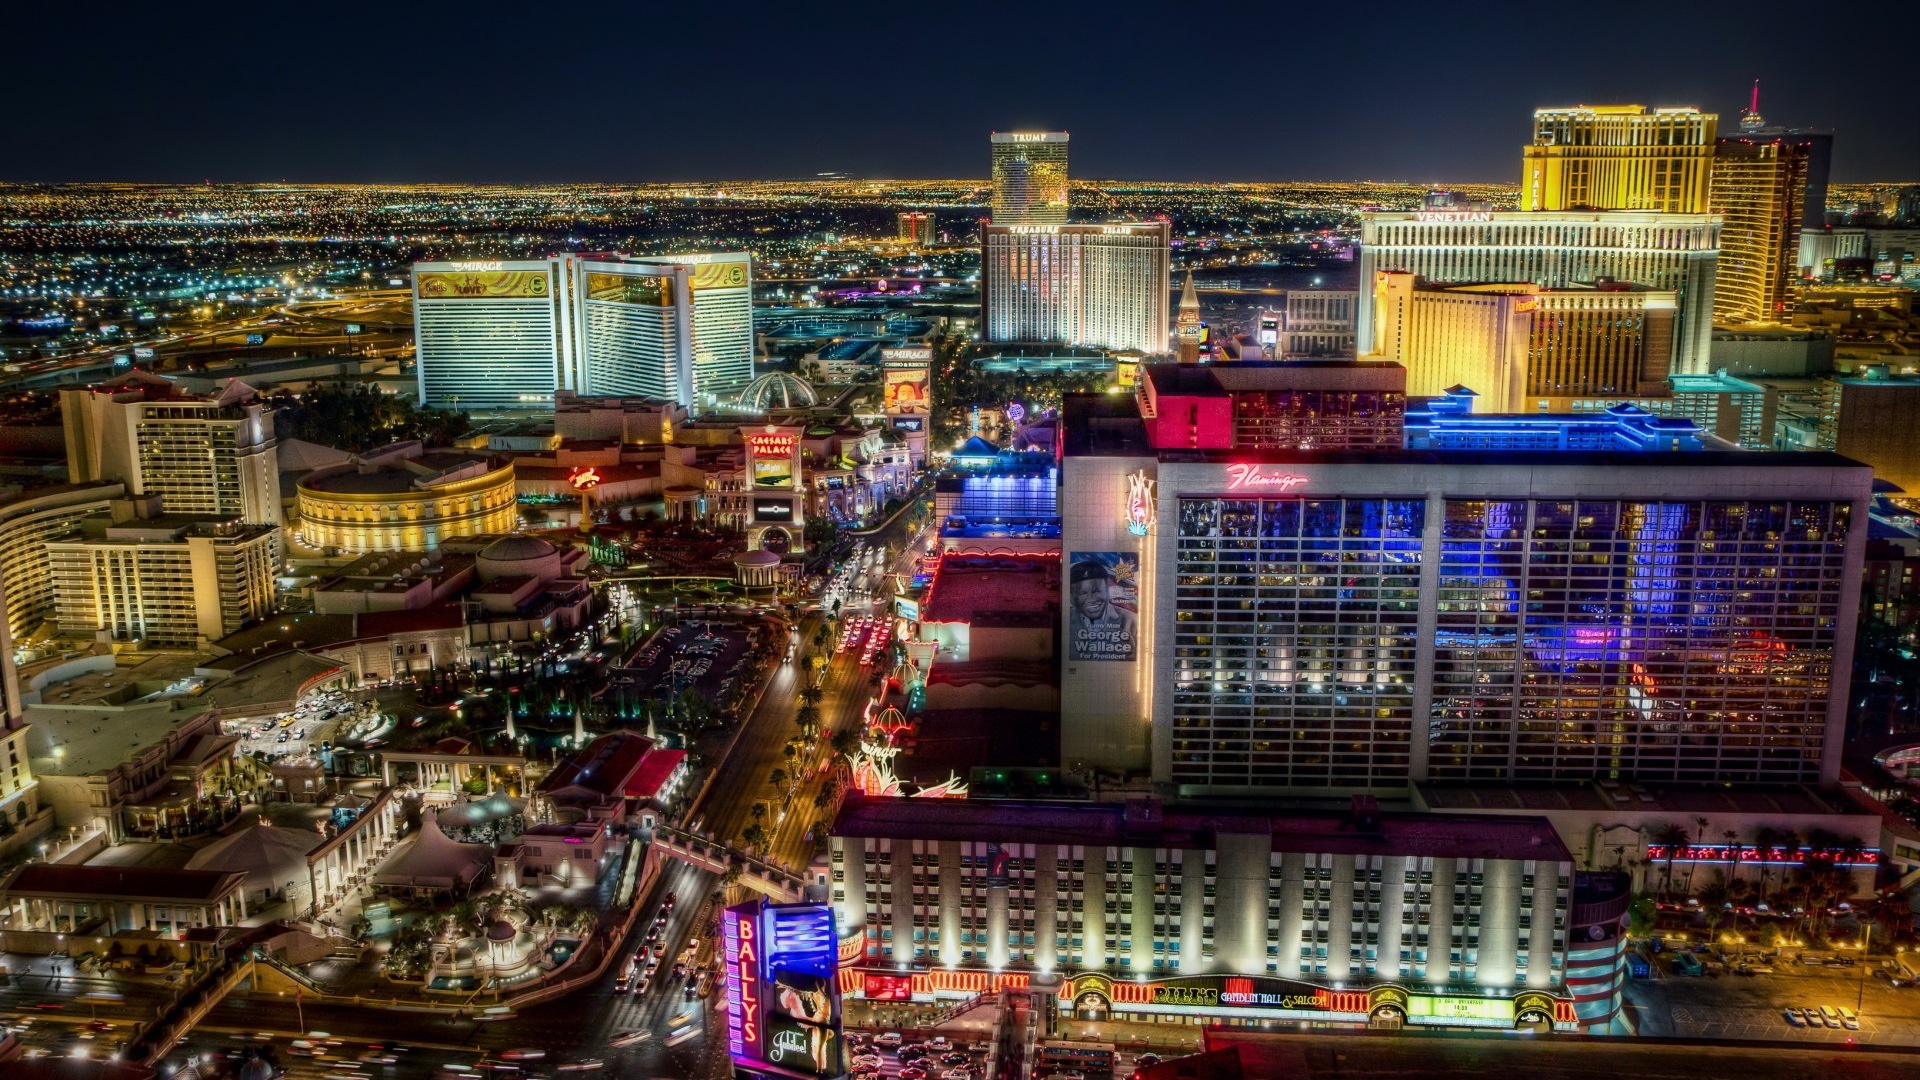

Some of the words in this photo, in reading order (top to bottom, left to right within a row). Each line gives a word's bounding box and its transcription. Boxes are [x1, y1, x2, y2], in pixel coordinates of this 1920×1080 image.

[1013, 134, 1046, 142] TRUMP
[1531, 169, 1540, 210] PALA
[1416, 212, 1490, 221] VENETIAN
[1010, 226, 1059, 234] TREASURE
[1103, 226, 1131, 234] ISLAND
[675, 255, 712, 264] MIRAGE
[459, 262, 503, 272] MIRAGE
[458, 286, 481, 294] LOVE
[889, 350, 930, 359] MIRAGE
[751, 437, 793, 445] CAESARS
[753, 446, 791, 454] PALACE
[1226, 463, 1308, 491] Flamingo
[1077, 629, 1129, 642] George
[1074, 641, 1132, 652] Wallace
[1153, 986, 1218, 1005] BILL'S
[1261, 993, 1282, 1004] HALL
[1282, 995, 1294, 1008] &
[1293, 995, 1327, 1006] SALOON
